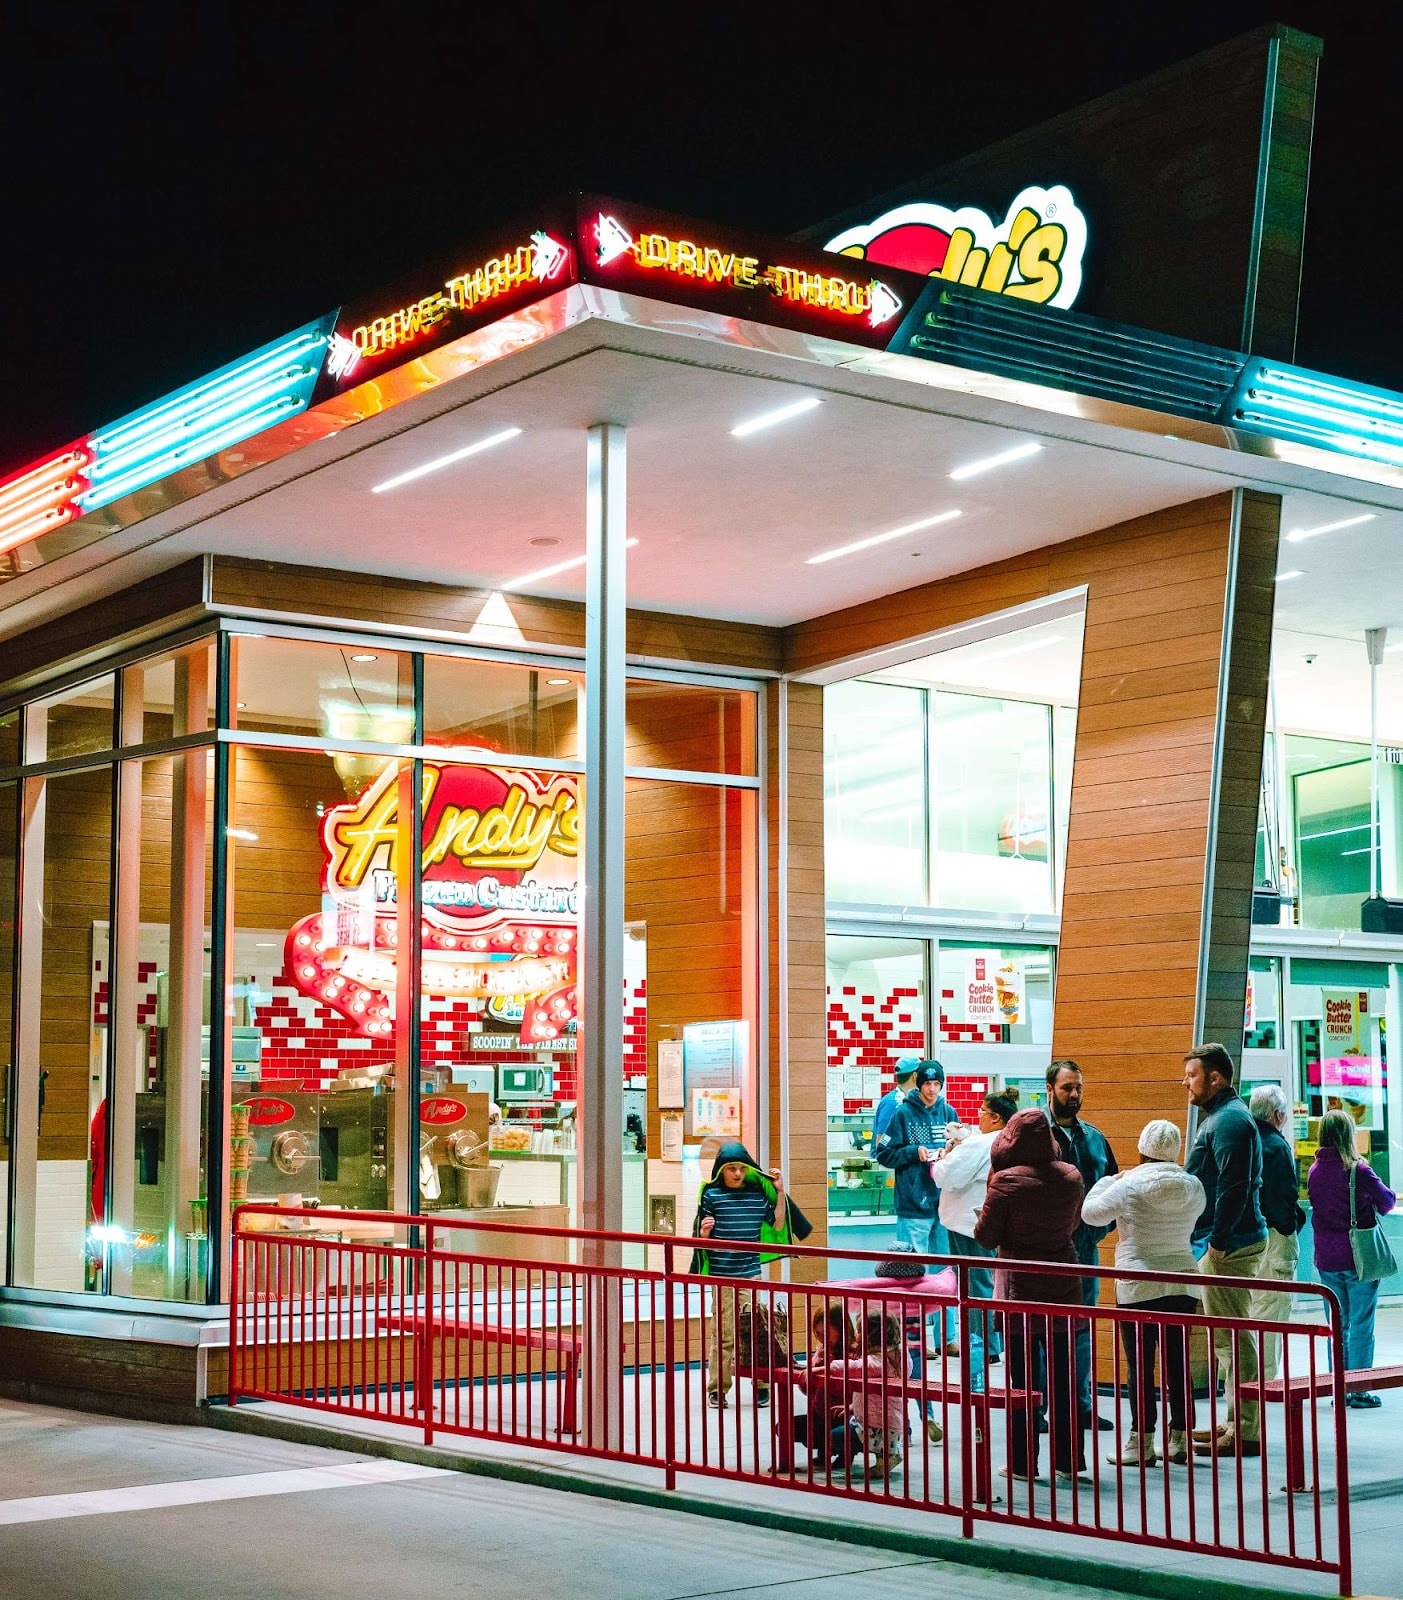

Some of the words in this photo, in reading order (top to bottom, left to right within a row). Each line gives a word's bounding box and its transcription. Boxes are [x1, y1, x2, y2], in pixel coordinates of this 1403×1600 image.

[371, 867, 475, 906] Fzen
[968, 983, 994, 996] Cookie
[968, 994, 994, 1005] Butter
[1326, 999, 1352, 1013] Cookie
[968, 1004, 995, 1014] CRUNCH
[1326, 1012, 1352, 1024] Butter
[1326, 1024, 1352, 1034] CRUNCH
[249, 1100, 285, 1119] Andy's
[424, 1101, 458, 1119] Andy's
